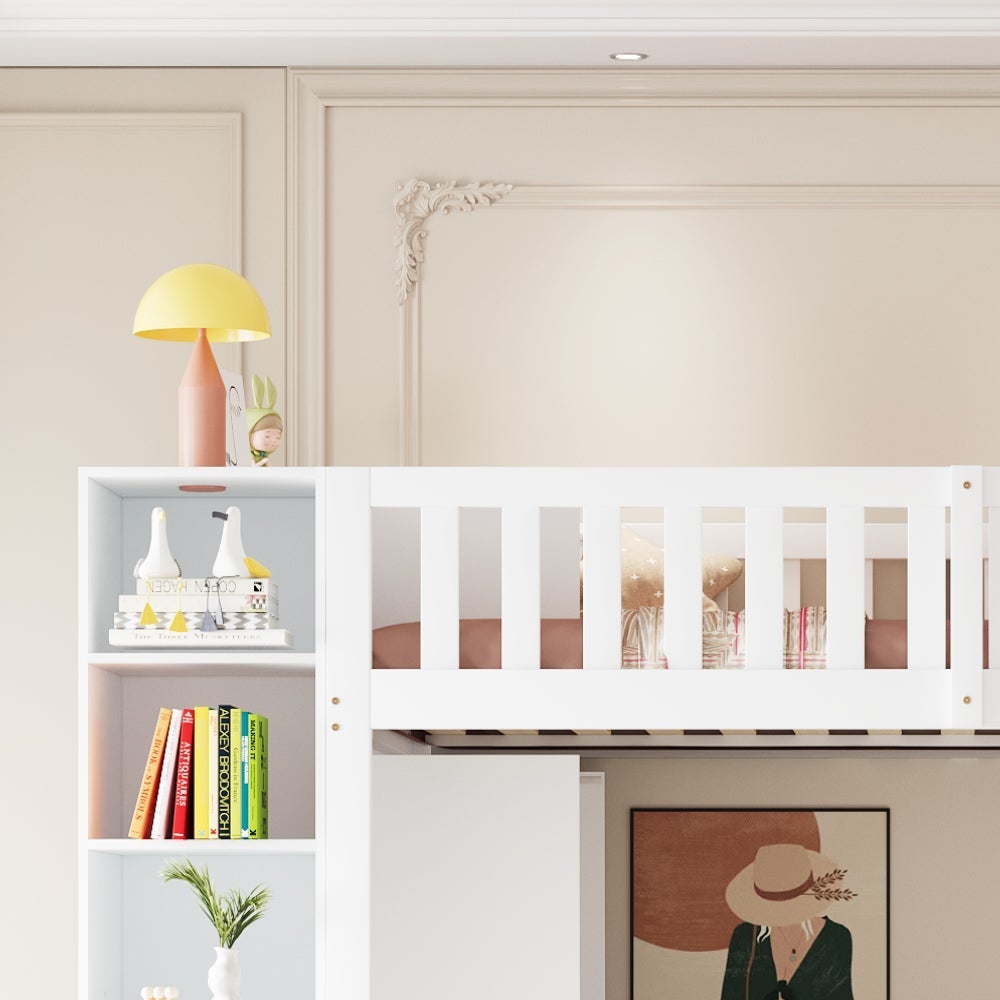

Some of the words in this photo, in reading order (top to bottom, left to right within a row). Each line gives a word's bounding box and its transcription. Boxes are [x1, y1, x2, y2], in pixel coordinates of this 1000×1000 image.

[219, 708, 230, 753] ALEXEY
[250, 752, 256, 760] IT
[178, 741, 192, 807] ANTIQUAIRES
[219, 755, 230, 831] BRODOVITCH
